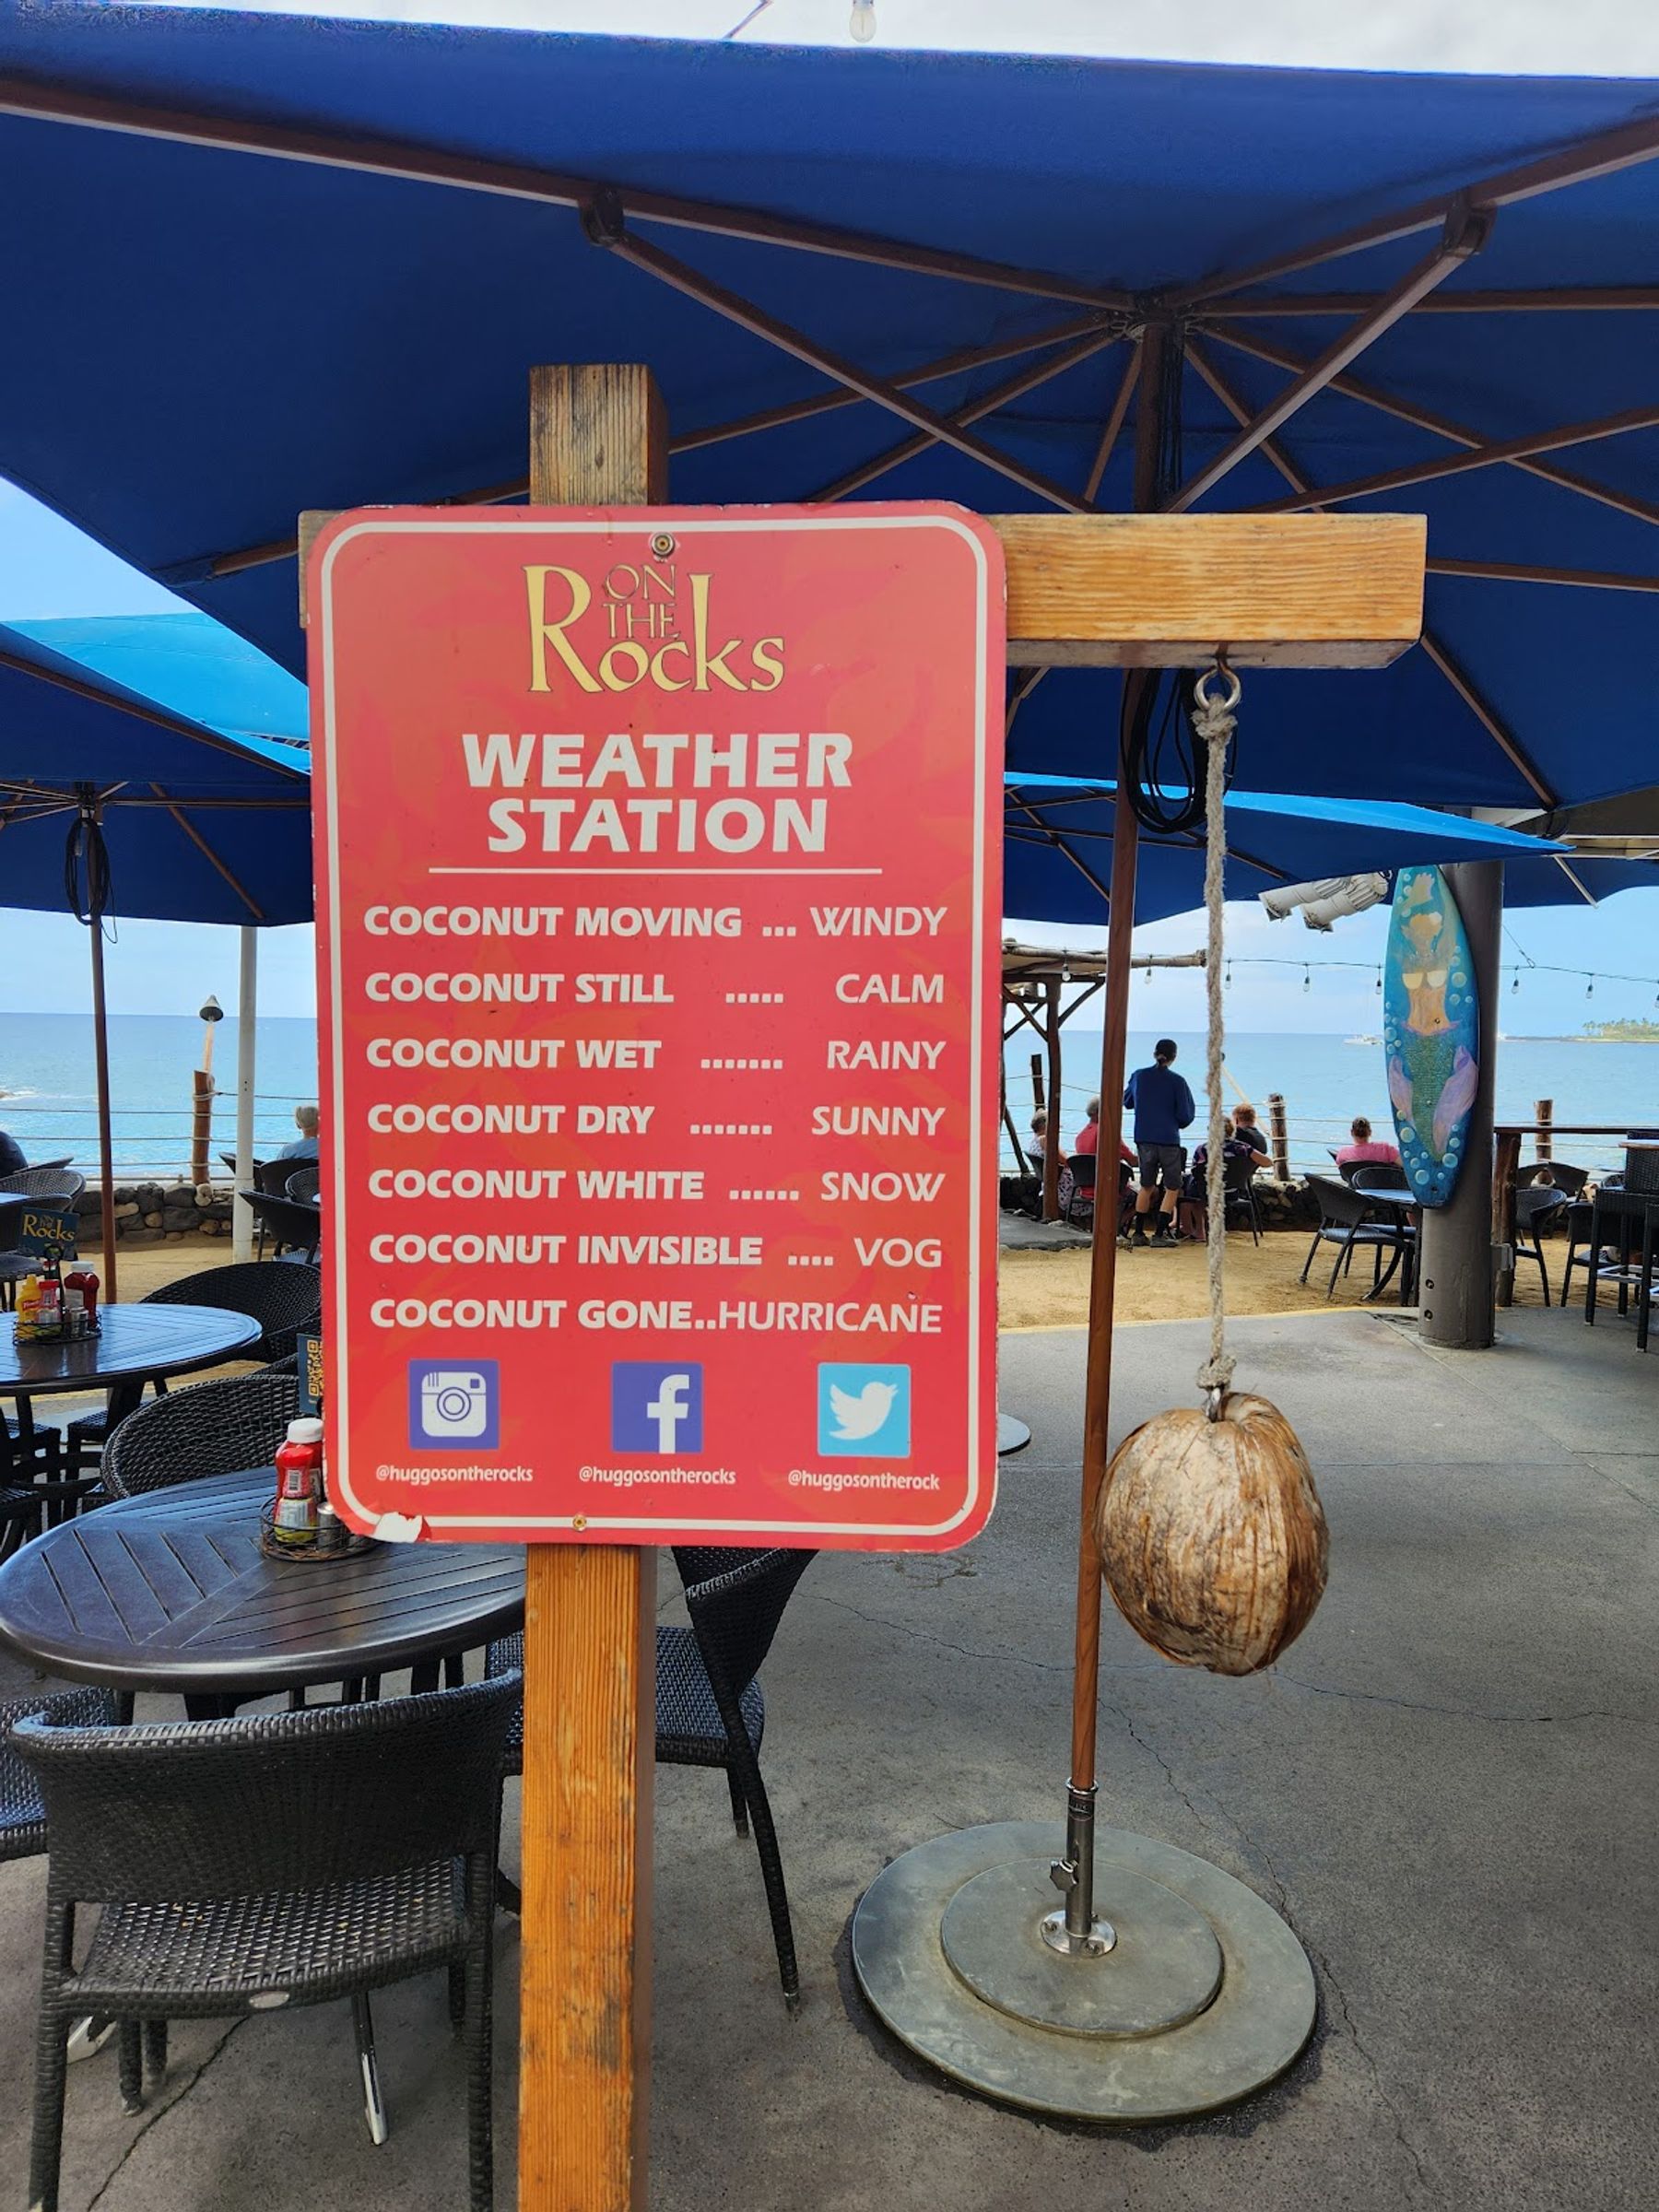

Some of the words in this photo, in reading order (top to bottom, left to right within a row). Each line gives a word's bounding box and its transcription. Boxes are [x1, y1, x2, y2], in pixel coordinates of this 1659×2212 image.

[604, 562, 677, 600] ON
[519, 562, 785, 694] Rocks
[601, 602, 683, 640] THE
[462, 733, 853, 789] WEATHER
[487, 798, 828, 853] STATION
[363, 905, 563, 936] COCONUT
[575, 907, 743, 937] MOVING
[810, 906, 947, 936] WINDY
[365, 972, 564, 1003] COCONUT
[575, 974, 675, 1003] STILL
[835, 973, 945, 1004] CALM
[366, 1038, 564, 1069] COCONUT
[576, 1040, 662, 1069] WET
[828, 1041, 946, 1070] RAINY
[368, 1103, 565, 1135] COCONUT
[577, 1105, 655, 1135] DRY
[812, 1105, 946, 1136] SUNNY
[369, 1169, 566, 1199] COCONUT
[577, 1171, 705, 1200] WHITE
[820, 1171, 946, 1202] SNOW
[22, 1214, 76, 1241] Rocks
[370, 1234, 566, 1265] COCONUT
[578, 1235, 763, 1265] INVISIBLE
[854, 1237, 942, 1268] VOG
[371, 1299, 567, 1328] COCONUT
[376, 1465, 534, 1486] @huggosontherocks
[578, 1465, 736, 1487] @huggosontherocks
[787, 1469, 941, 1492] @huggosontherock
